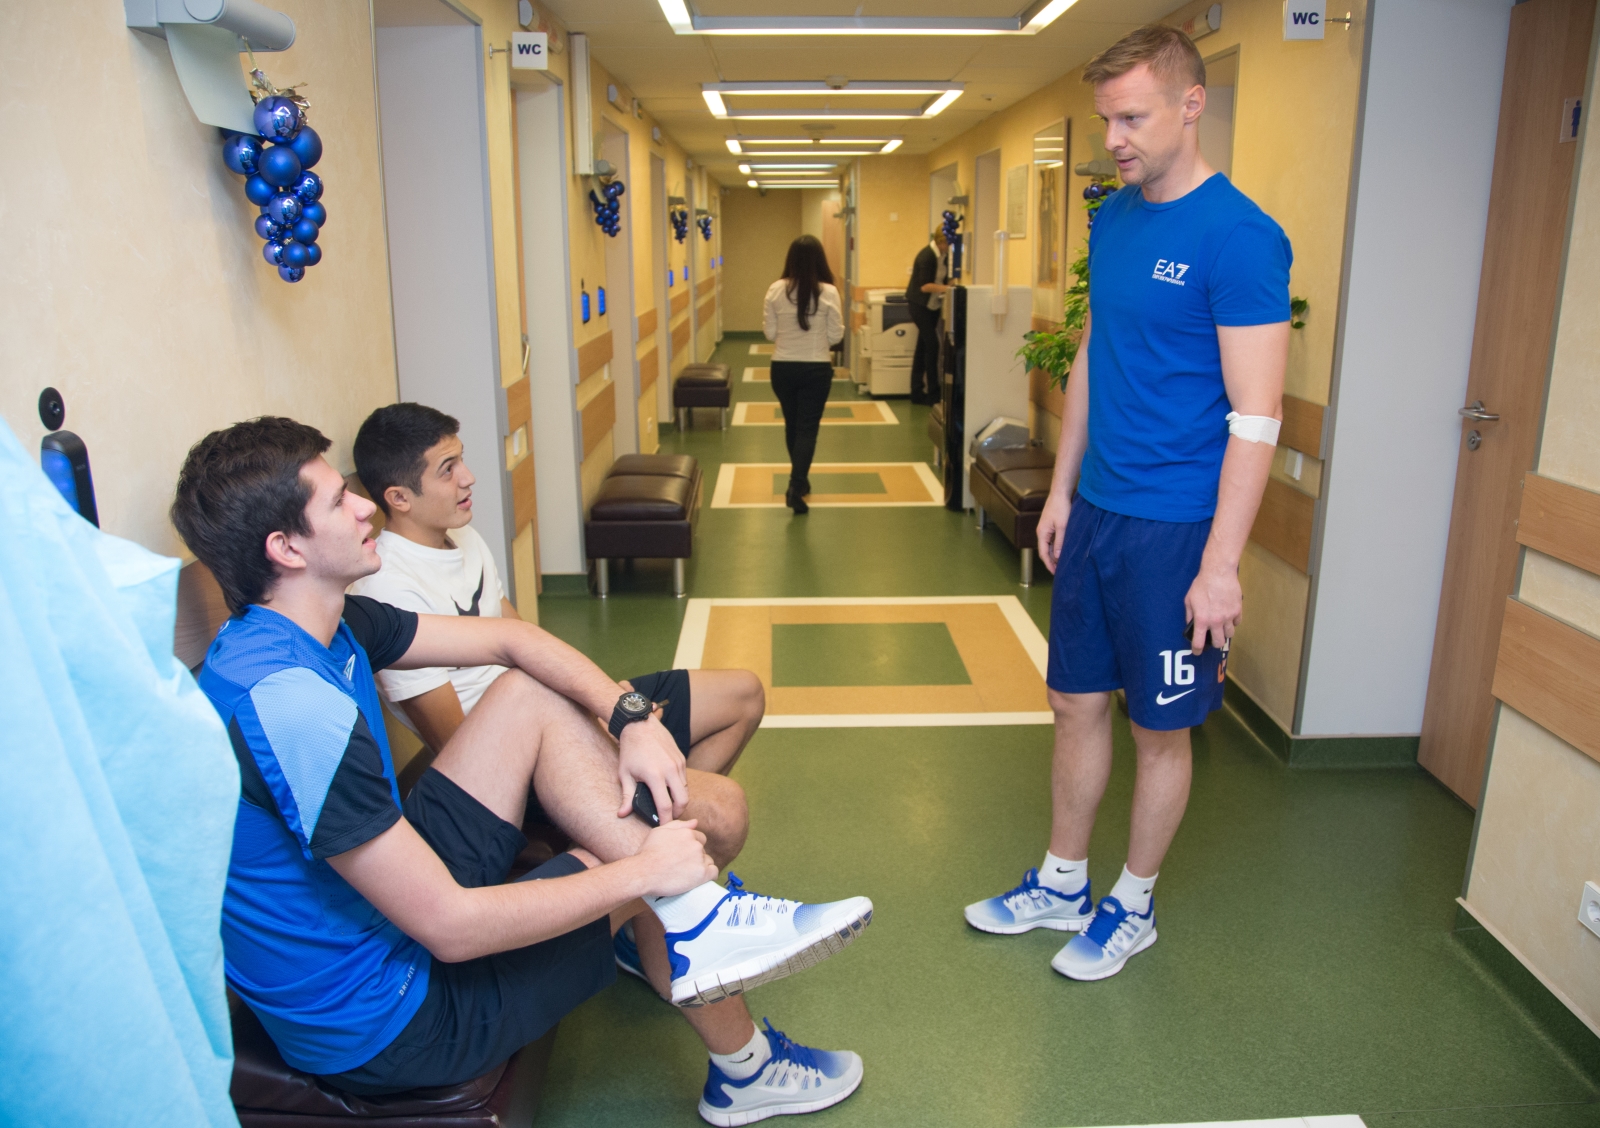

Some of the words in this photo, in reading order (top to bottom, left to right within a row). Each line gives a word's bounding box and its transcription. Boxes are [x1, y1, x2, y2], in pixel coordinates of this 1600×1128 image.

[1292, 12, 1319, 25] WC
[517, 44, 542, 55] WC
[1153, 259, 1190, 279] EA7
[1159, 649, 1195, 686] 16
[399, 965, 415, 996] DRI-FIT
